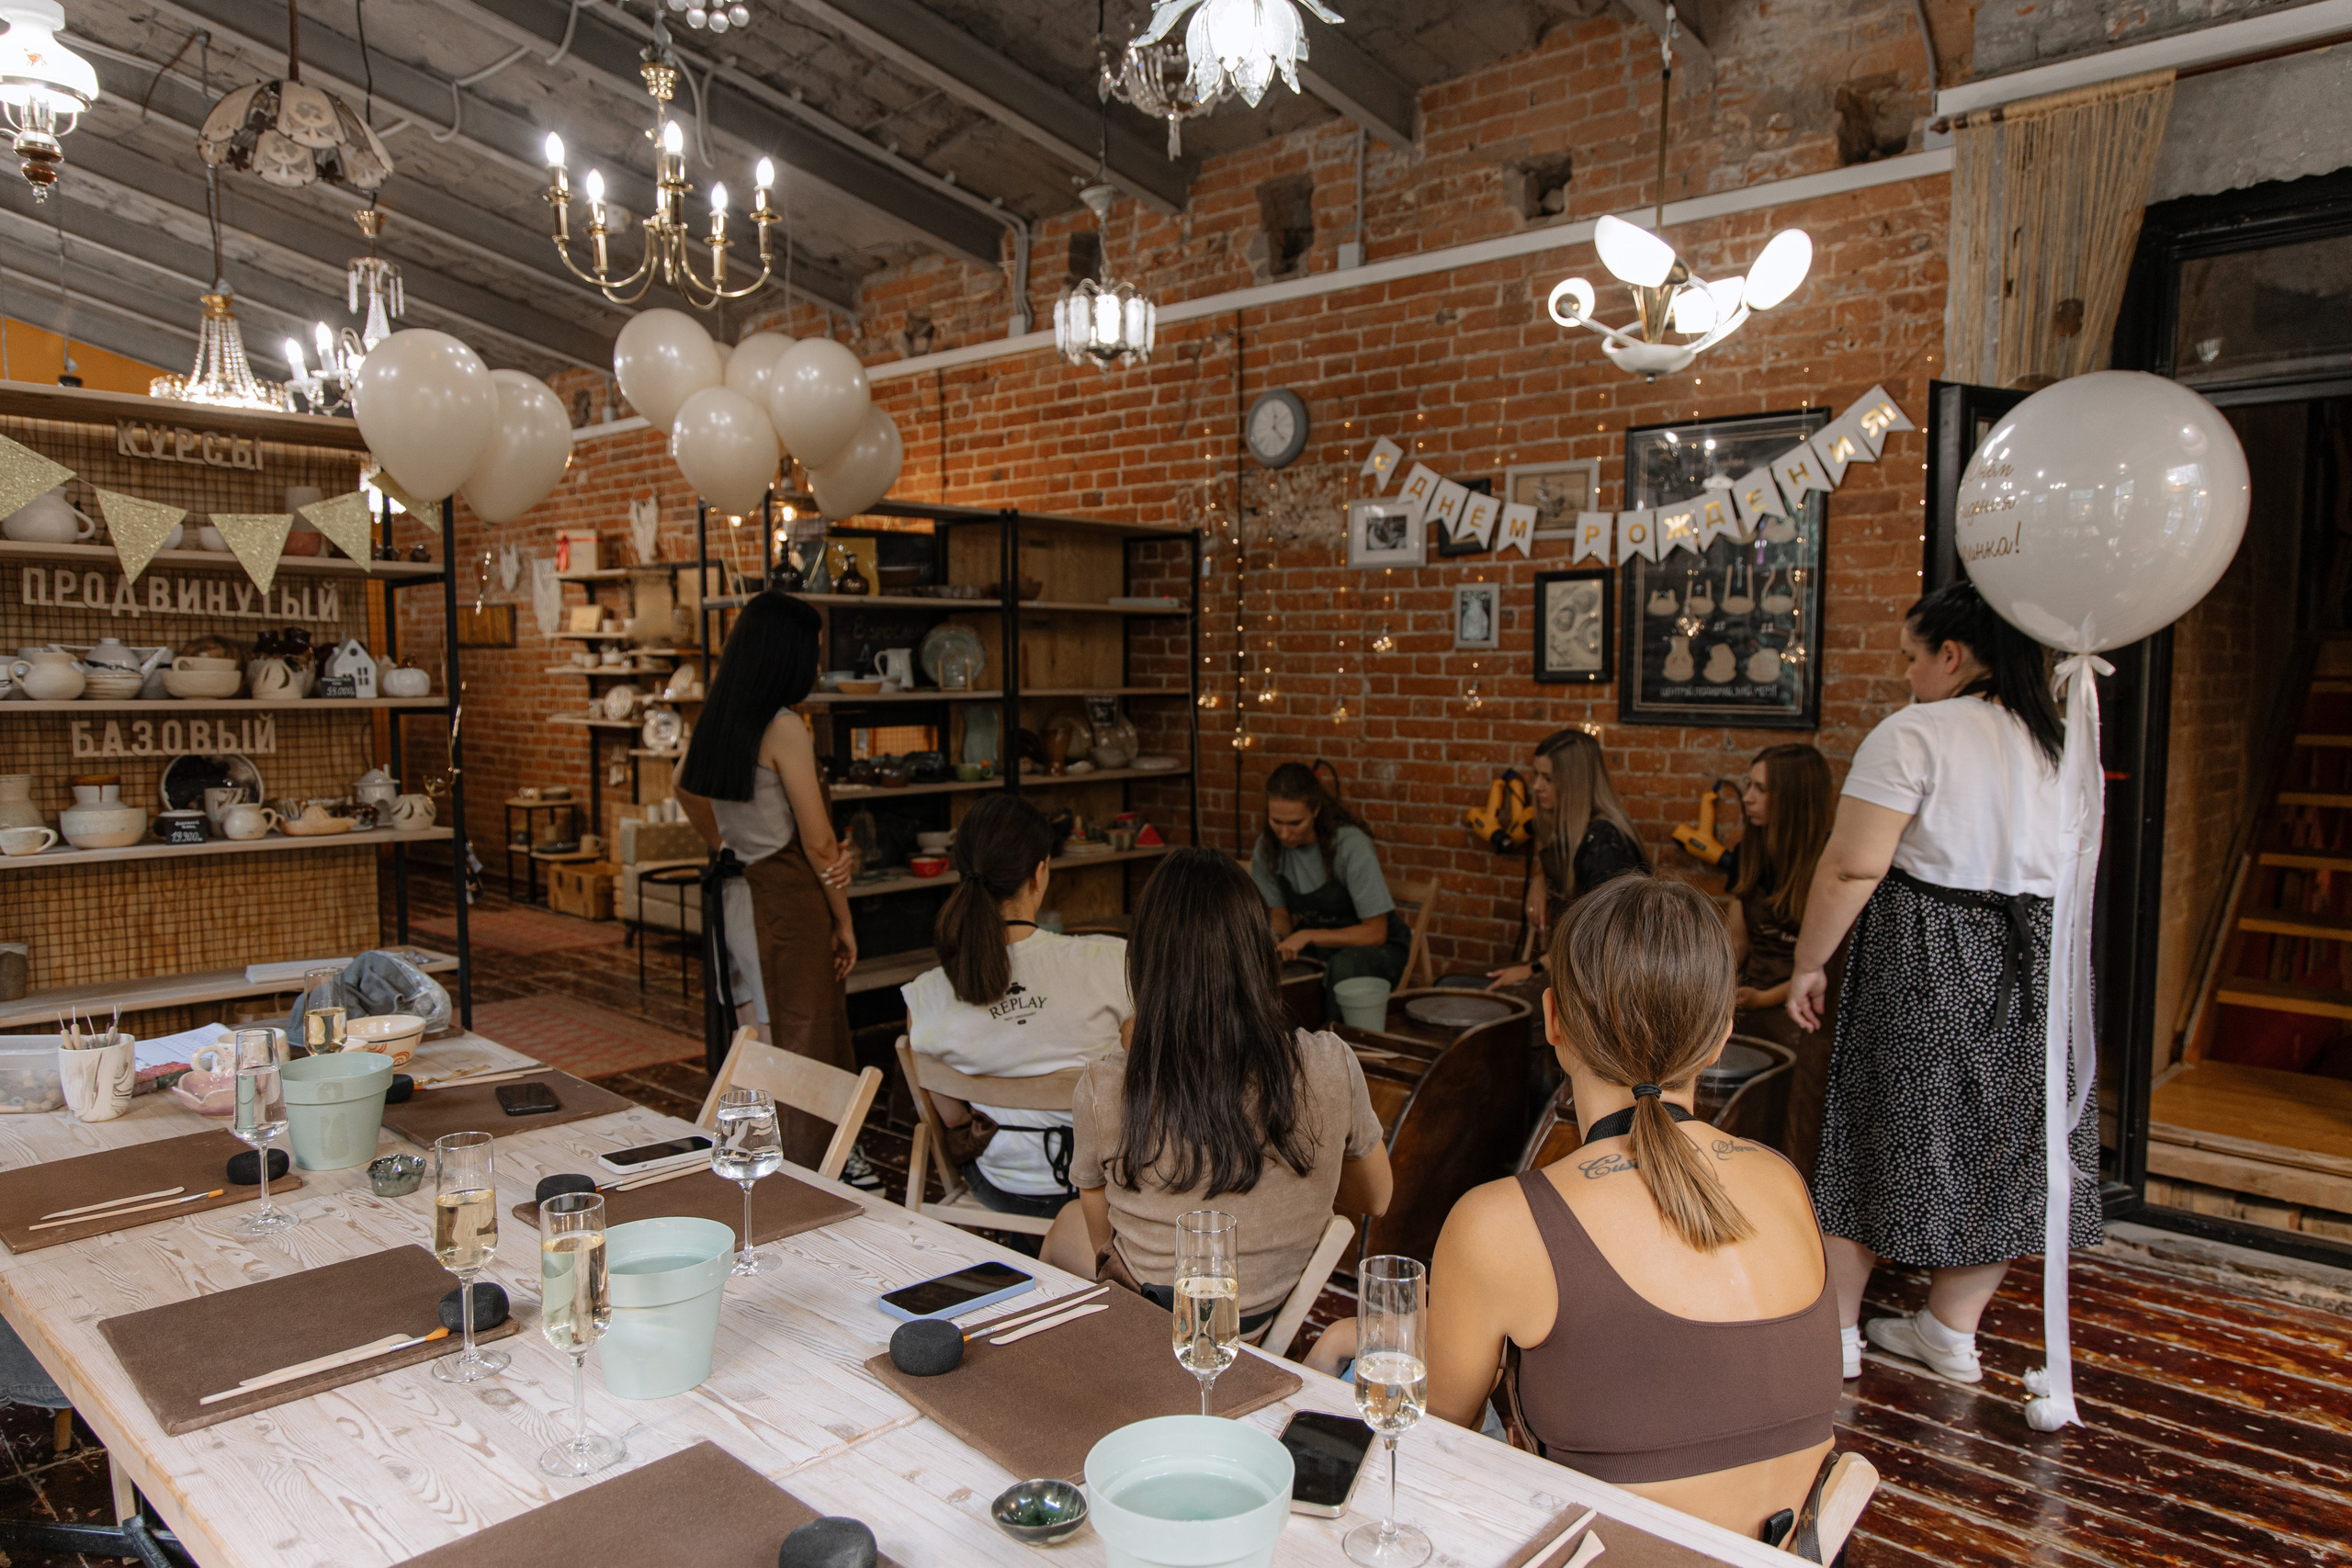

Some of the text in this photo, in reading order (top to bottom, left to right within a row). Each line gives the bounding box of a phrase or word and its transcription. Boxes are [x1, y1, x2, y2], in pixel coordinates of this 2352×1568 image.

[116, 418, 264, 471] КУРСЫ
[1374, 401, 1897, 546] С ДНЁМ РОЖДЕНИЯ!
[22, 567, 340, 622] ПРОДВИНУТЫЙ
[71, 713, 276, 759] БАЗОВЫЙ
[989, 996, 1047, 1021] REPLAY
